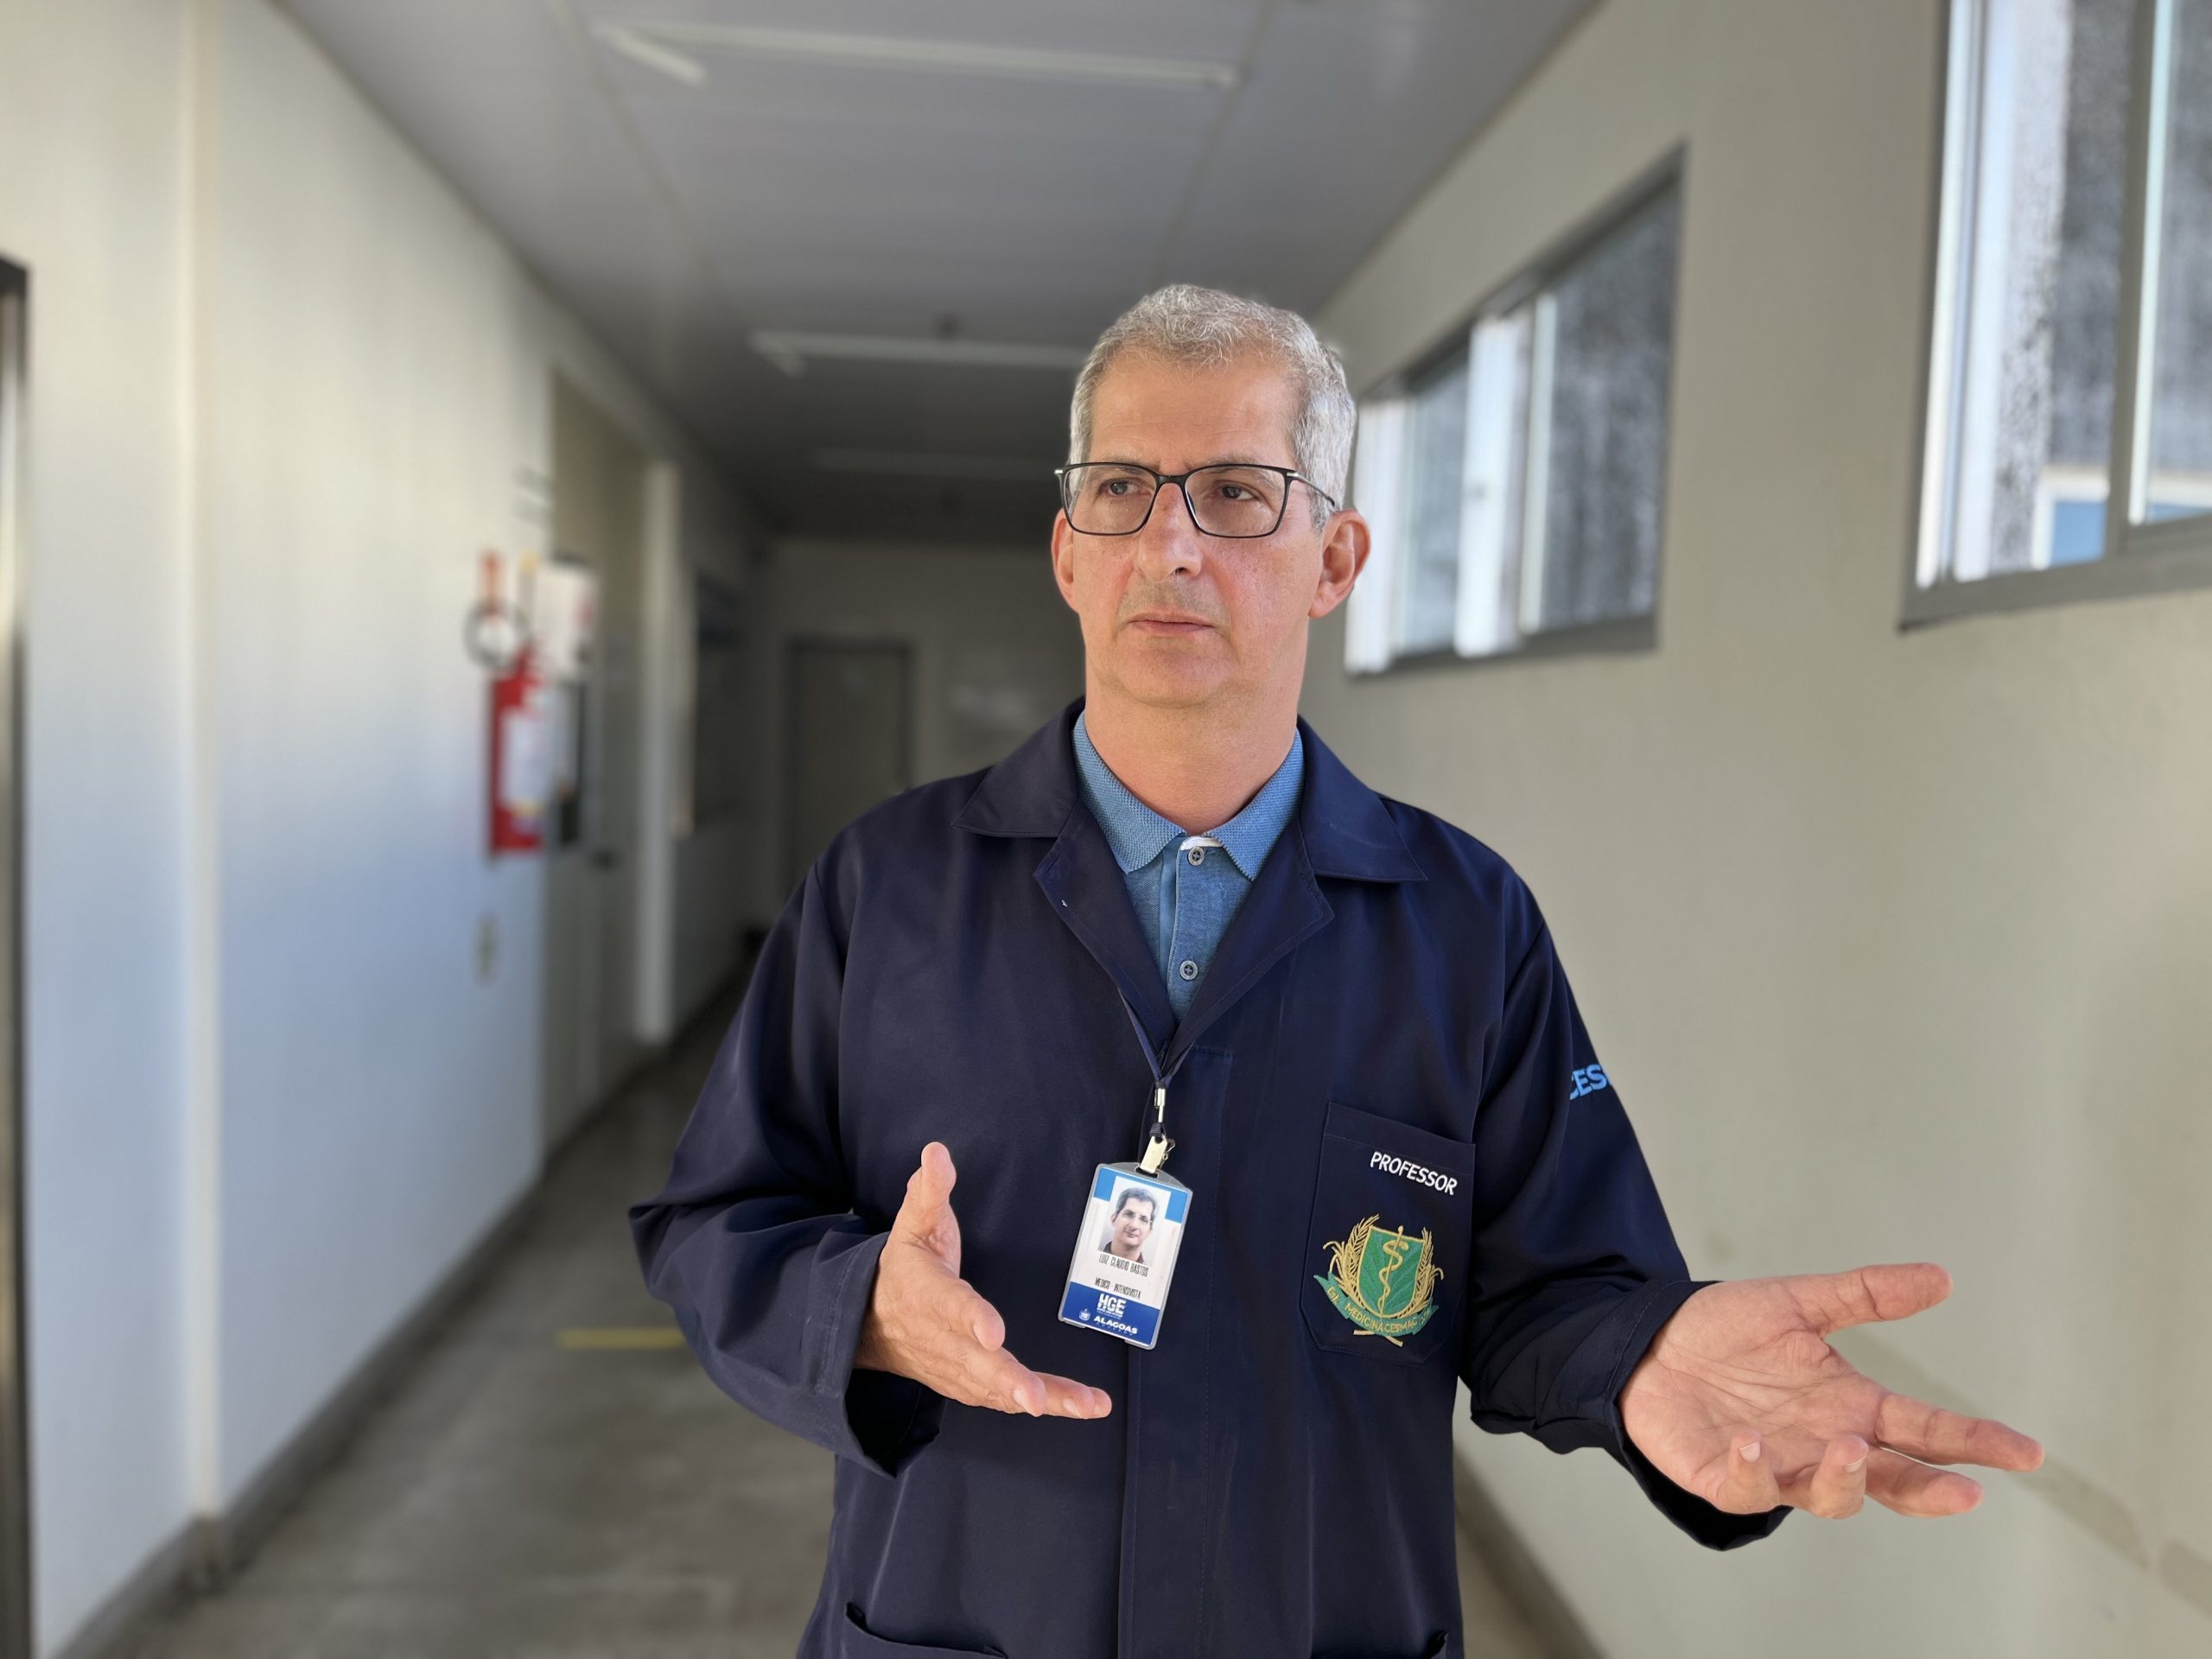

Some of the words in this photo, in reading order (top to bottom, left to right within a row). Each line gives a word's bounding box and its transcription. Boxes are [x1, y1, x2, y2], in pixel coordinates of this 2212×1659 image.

[1370, 1151, 1458, 1195] PROFESSOR
[1098, 1253, 1110, 1265] LUIZ
[1110, 1256, 1130, 1271] CLAUDIO
[1130, 1262, 1149, 1277] BASTOS
[1096, 1293, 1127, 1315] HGE
[1093, 1315, 1138, 1334] ALAGOAS
[1344, 1303, 1383, 1332] MEDICINA
